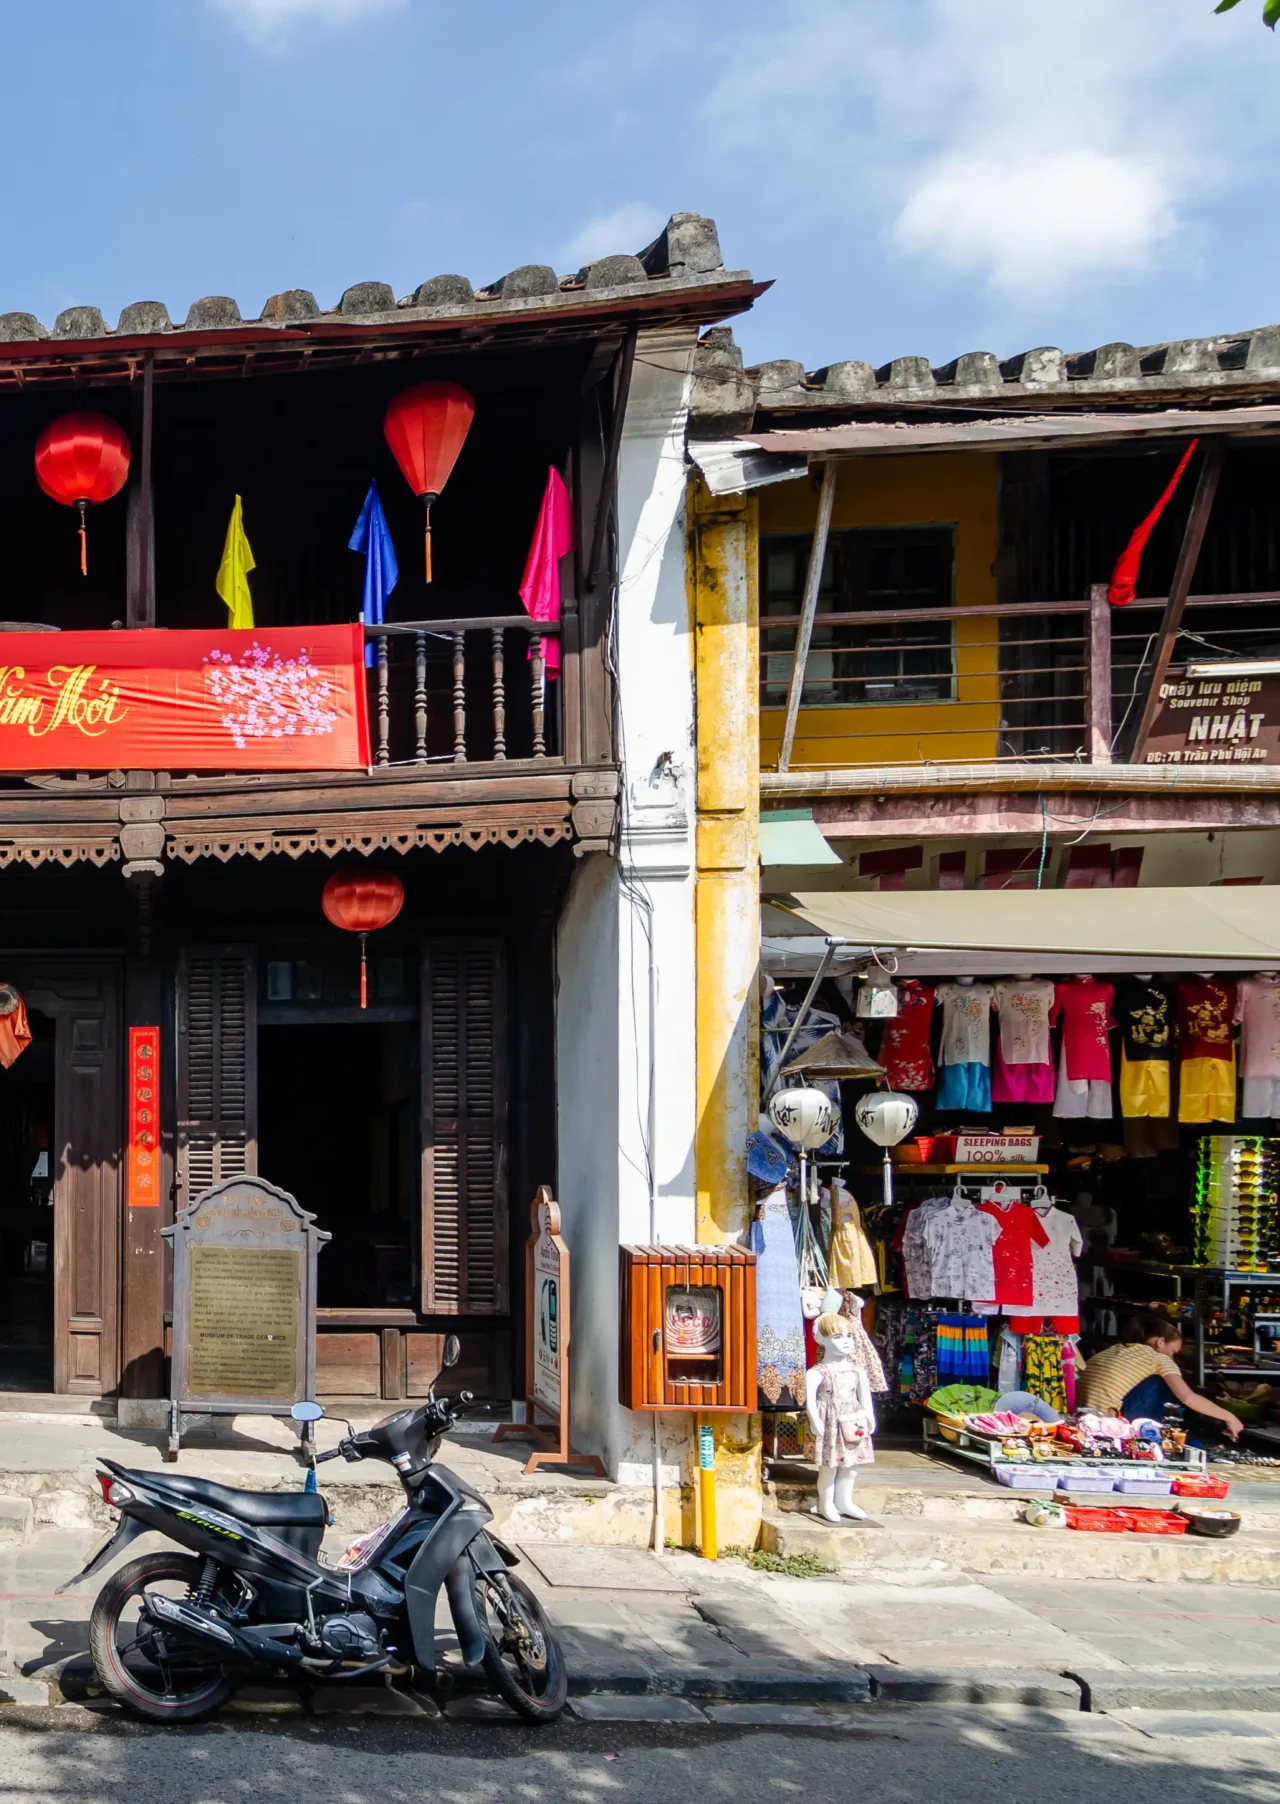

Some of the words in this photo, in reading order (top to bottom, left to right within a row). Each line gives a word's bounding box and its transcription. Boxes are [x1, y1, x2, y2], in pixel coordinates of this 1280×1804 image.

[1226, 679, 1263, 696] niệm
[28, 664, 130, 737] Mới
[1169, 698, 1218, 709] Souvenir
[1222, 695, 1251, 707] Shop
[1188, 709, 1265, 744] NHẬT
[1210, 746, 1234, 760] Phú
[1234, 748, 1251, 761] Hội
[1252, 748, 1268, 758] An
[963, 1138, 1006, 1147] SLEEPING
[1007, 1138, 1032, 1147] BAGS
[967, 1149, 1006, 1162] 100%
[1010, 1154, 1026, 1162] silk
[256, 1333, 286, 1341] CERMICS
[176, 1511, 243, 1540] SIRIUS
